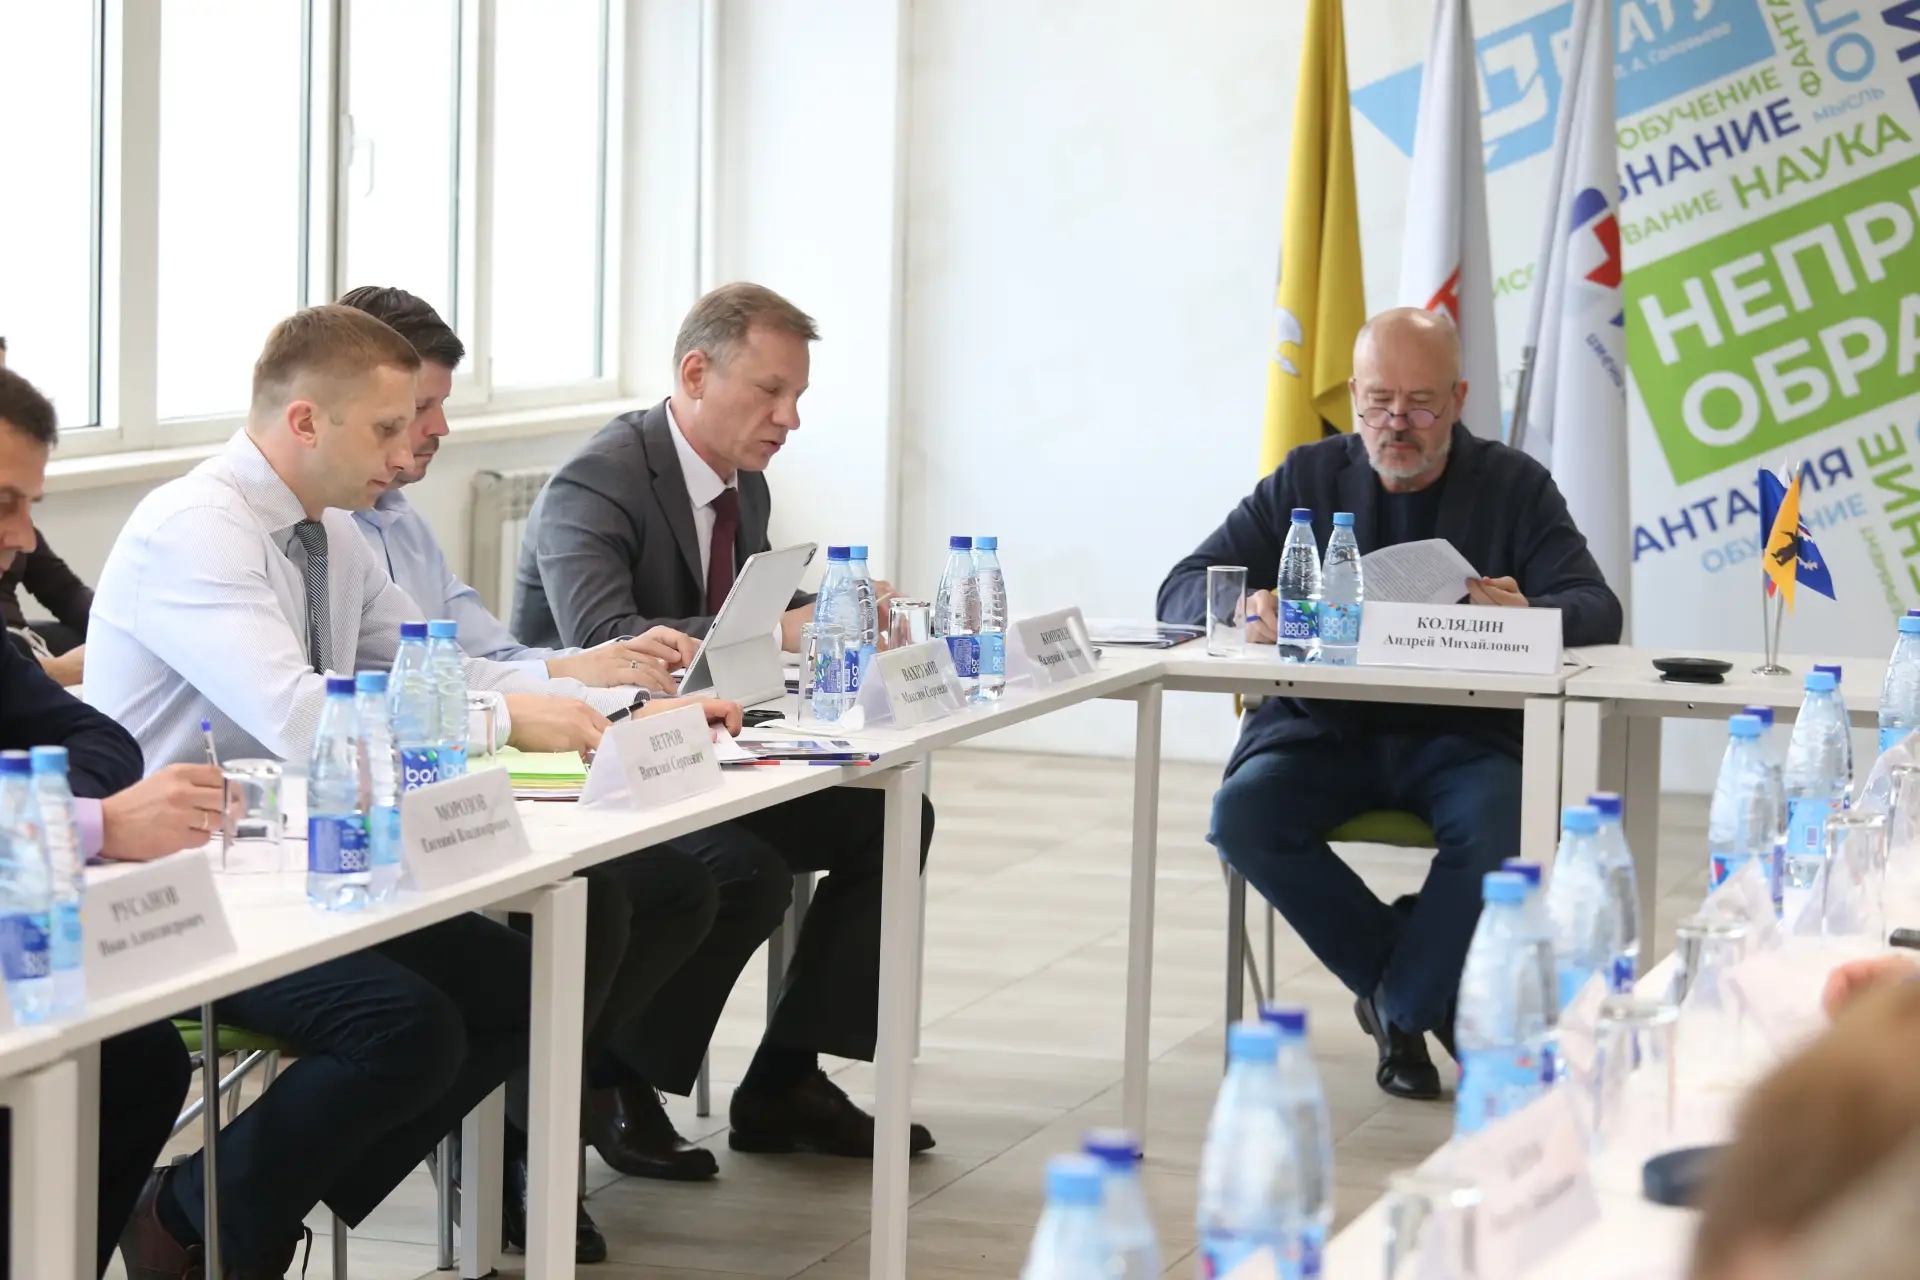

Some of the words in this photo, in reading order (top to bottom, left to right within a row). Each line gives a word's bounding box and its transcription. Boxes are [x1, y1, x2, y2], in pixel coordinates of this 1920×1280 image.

[1617, 66, 1782, 150] ОБУЧЕНИЕ
[1812, 87, 1885, 123] МЫСЛЬ
[1731, 112, 1913, 210] НАУКА
[1637, 187, 1920, 366] НЕПР
[1417, 616, 1504, 633] КОЛЯДИН
[1383, 634, 1435, 649] Андрей
[1440, 637, 1529, 653] Михайлович
[649, 729, 684, 752] ВЕТРОВ
[434, 793, 488, 821] МОРОЗОВ
